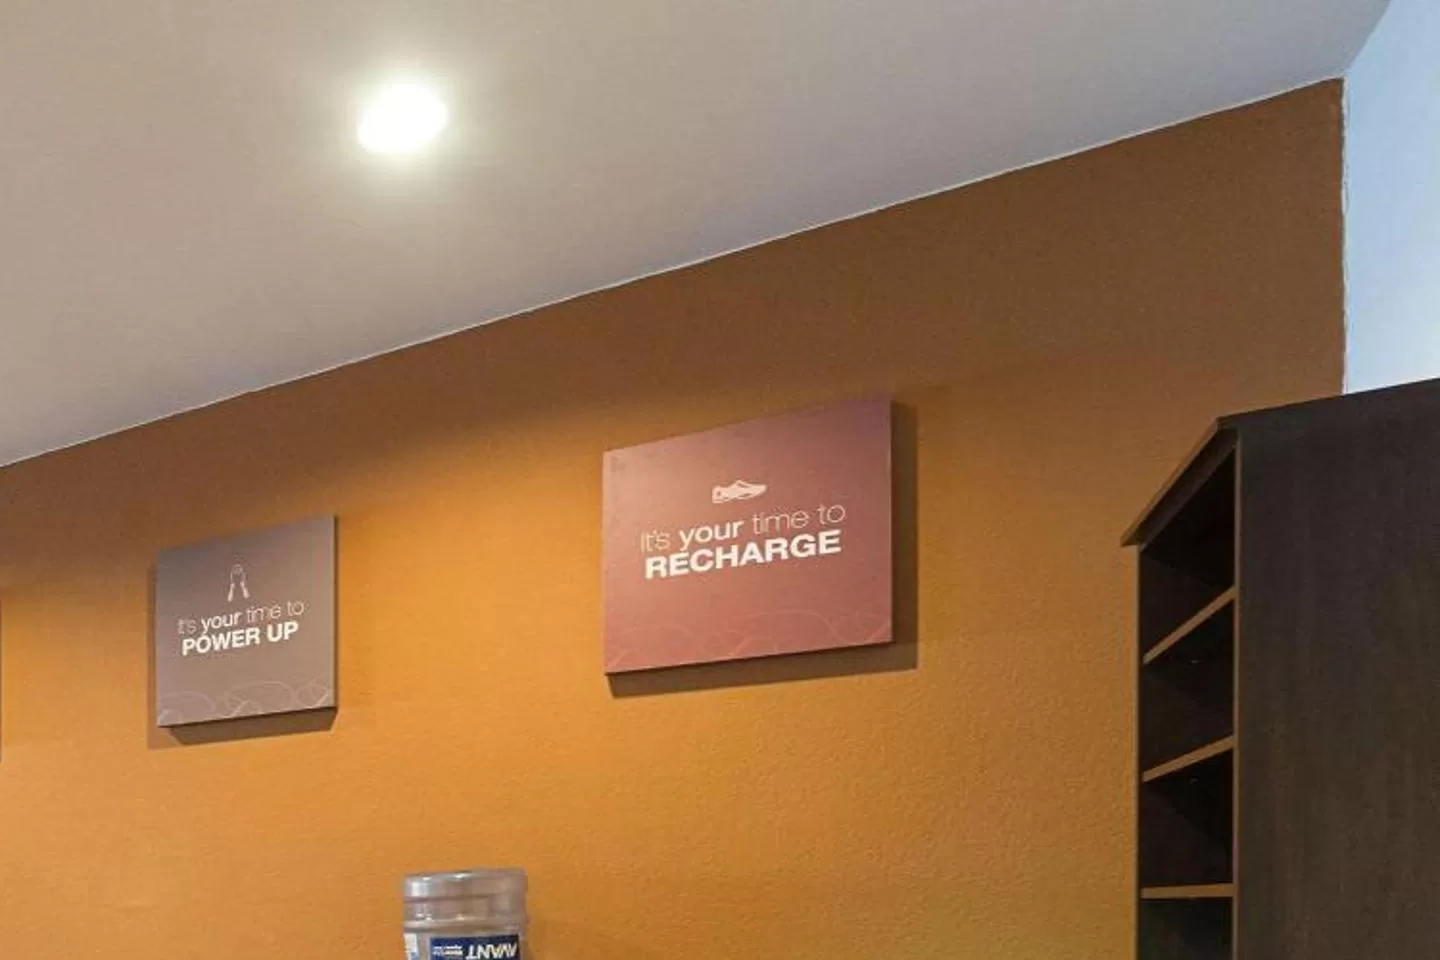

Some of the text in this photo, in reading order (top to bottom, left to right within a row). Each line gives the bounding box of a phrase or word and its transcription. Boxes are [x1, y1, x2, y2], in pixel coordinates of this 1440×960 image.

[678, 521, 744, 551] your
[753, 511, 809, 534] time
[818, 504, 846, 525] to
[645, 529, 841, 579] RECHARGE
[201, 612, 241, 636] your
[246, 604, 281, 624] time
[287, 600, 305, 617] to
[182, 620, 299, 656] POWER UP
[465, 943, 517, 960] AVANT
